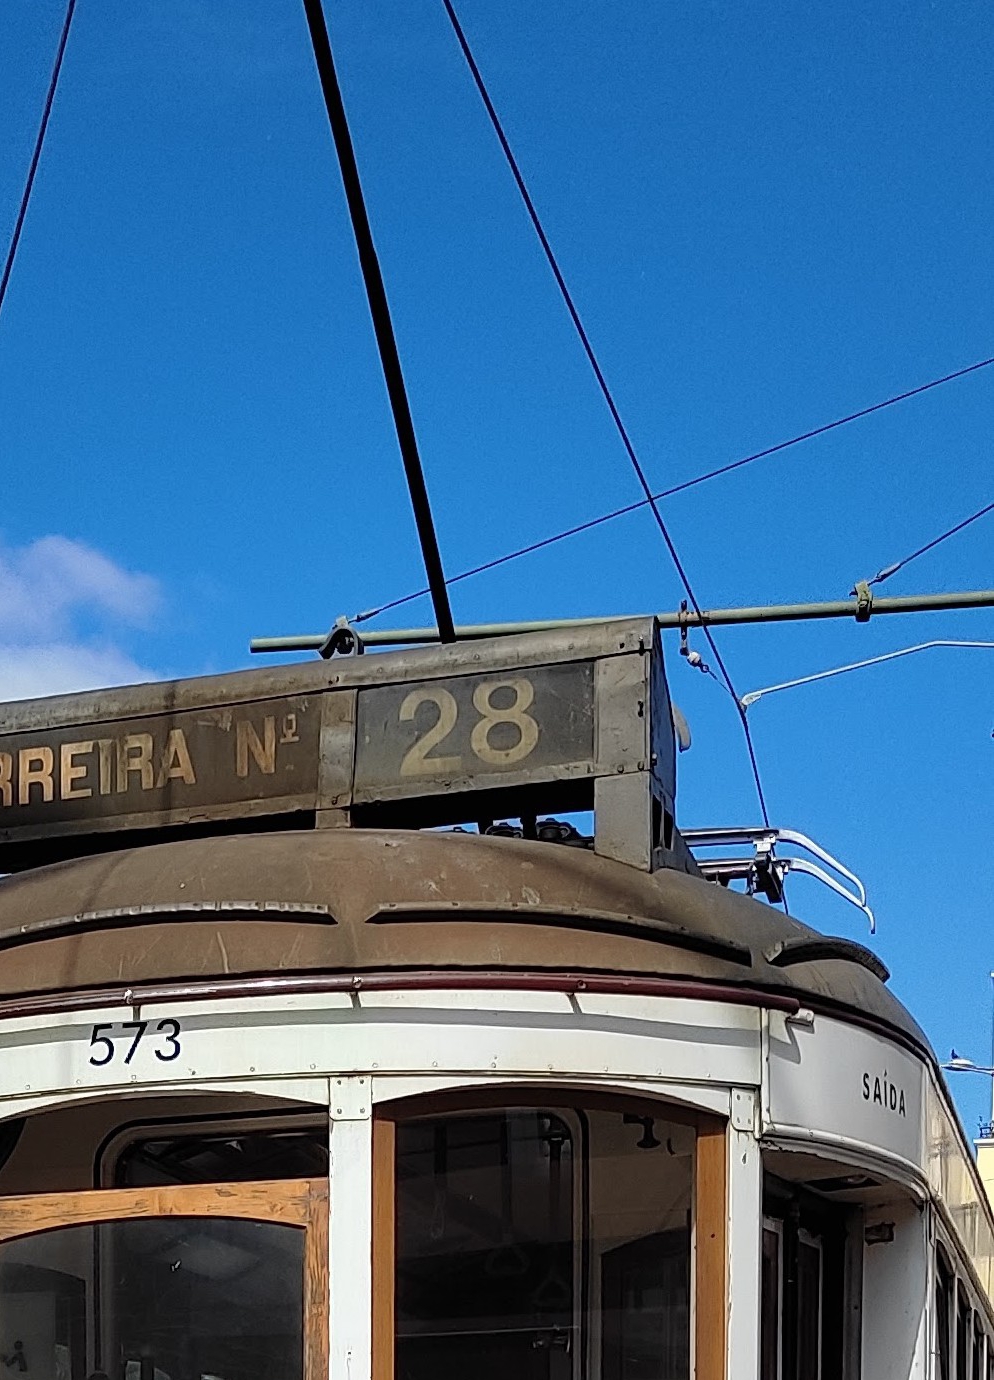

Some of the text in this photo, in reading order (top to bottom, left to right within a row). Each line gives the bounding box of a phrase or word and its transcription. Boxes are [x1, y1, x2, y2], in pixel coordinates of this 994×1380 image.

[398, 677, 539, 776] 28
[89, 1019, 181, 1066] 573
[862, 1068, 906, 1118] SAÍDA
